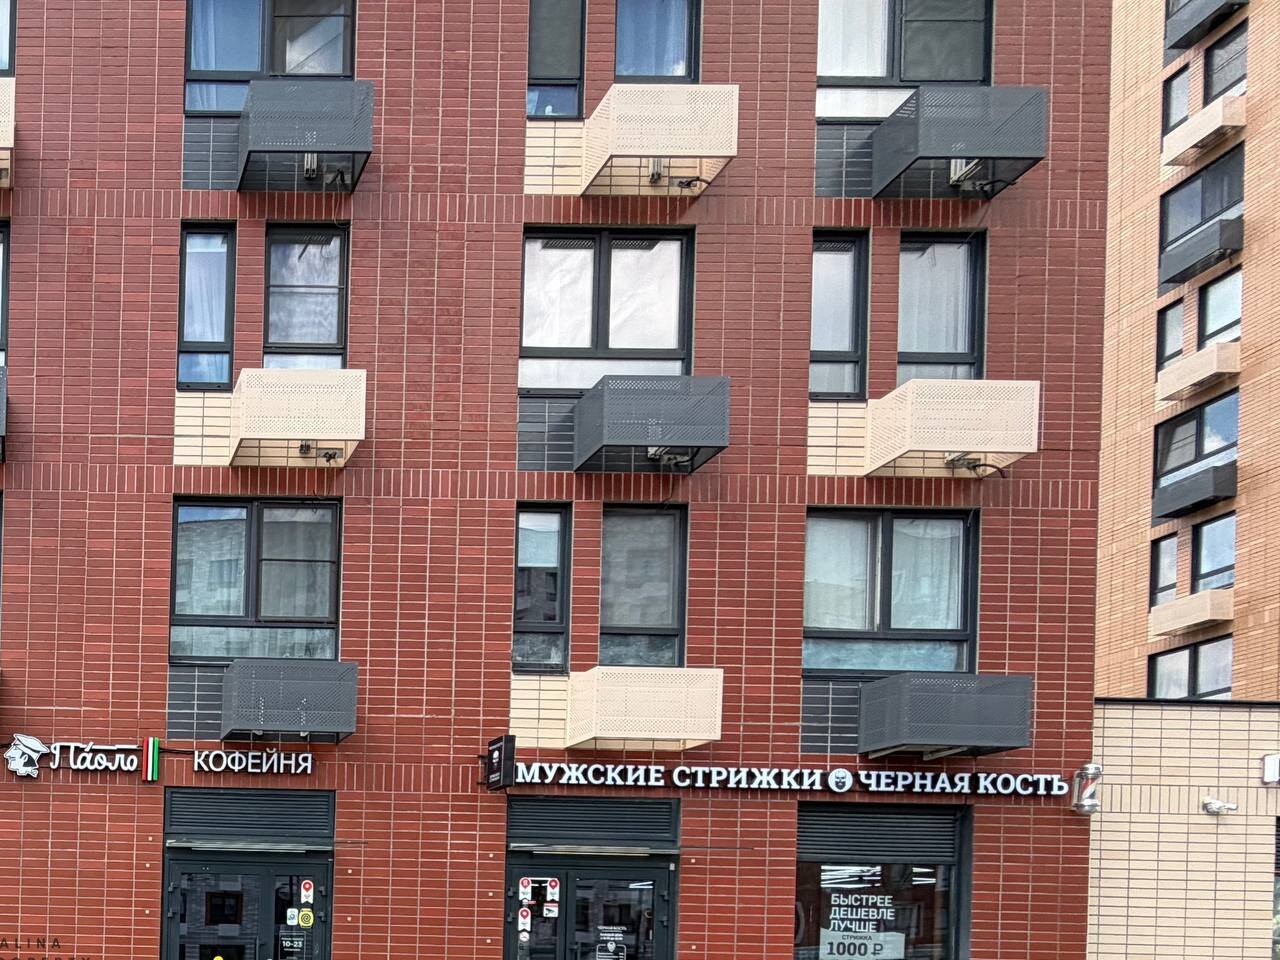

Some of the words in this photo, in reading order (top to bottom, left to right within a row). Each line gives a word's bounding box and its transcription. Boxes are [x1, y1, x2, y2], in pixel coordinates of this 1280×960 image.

[193, 748, 312, 774] КОФЕЙНЯ
[516, 762, 665, 787] МУЖСКИЕ
[672, 765, 823, 790] СТРИЖКИ
[858, 770, 971, 794] ЧЕРНАЯ
[977, 773, 1069, 796] КОСТЬ
[831, 893, 893, 907] БЫСТРЕЕ
[829, 906, 896, 920] ДЕШЕВЛЕ
[829, 920, 877, 932] ЛУЧШЕ
[282, 940, 303, 948] 10-23
[827, 942, 868, 956] 1000
